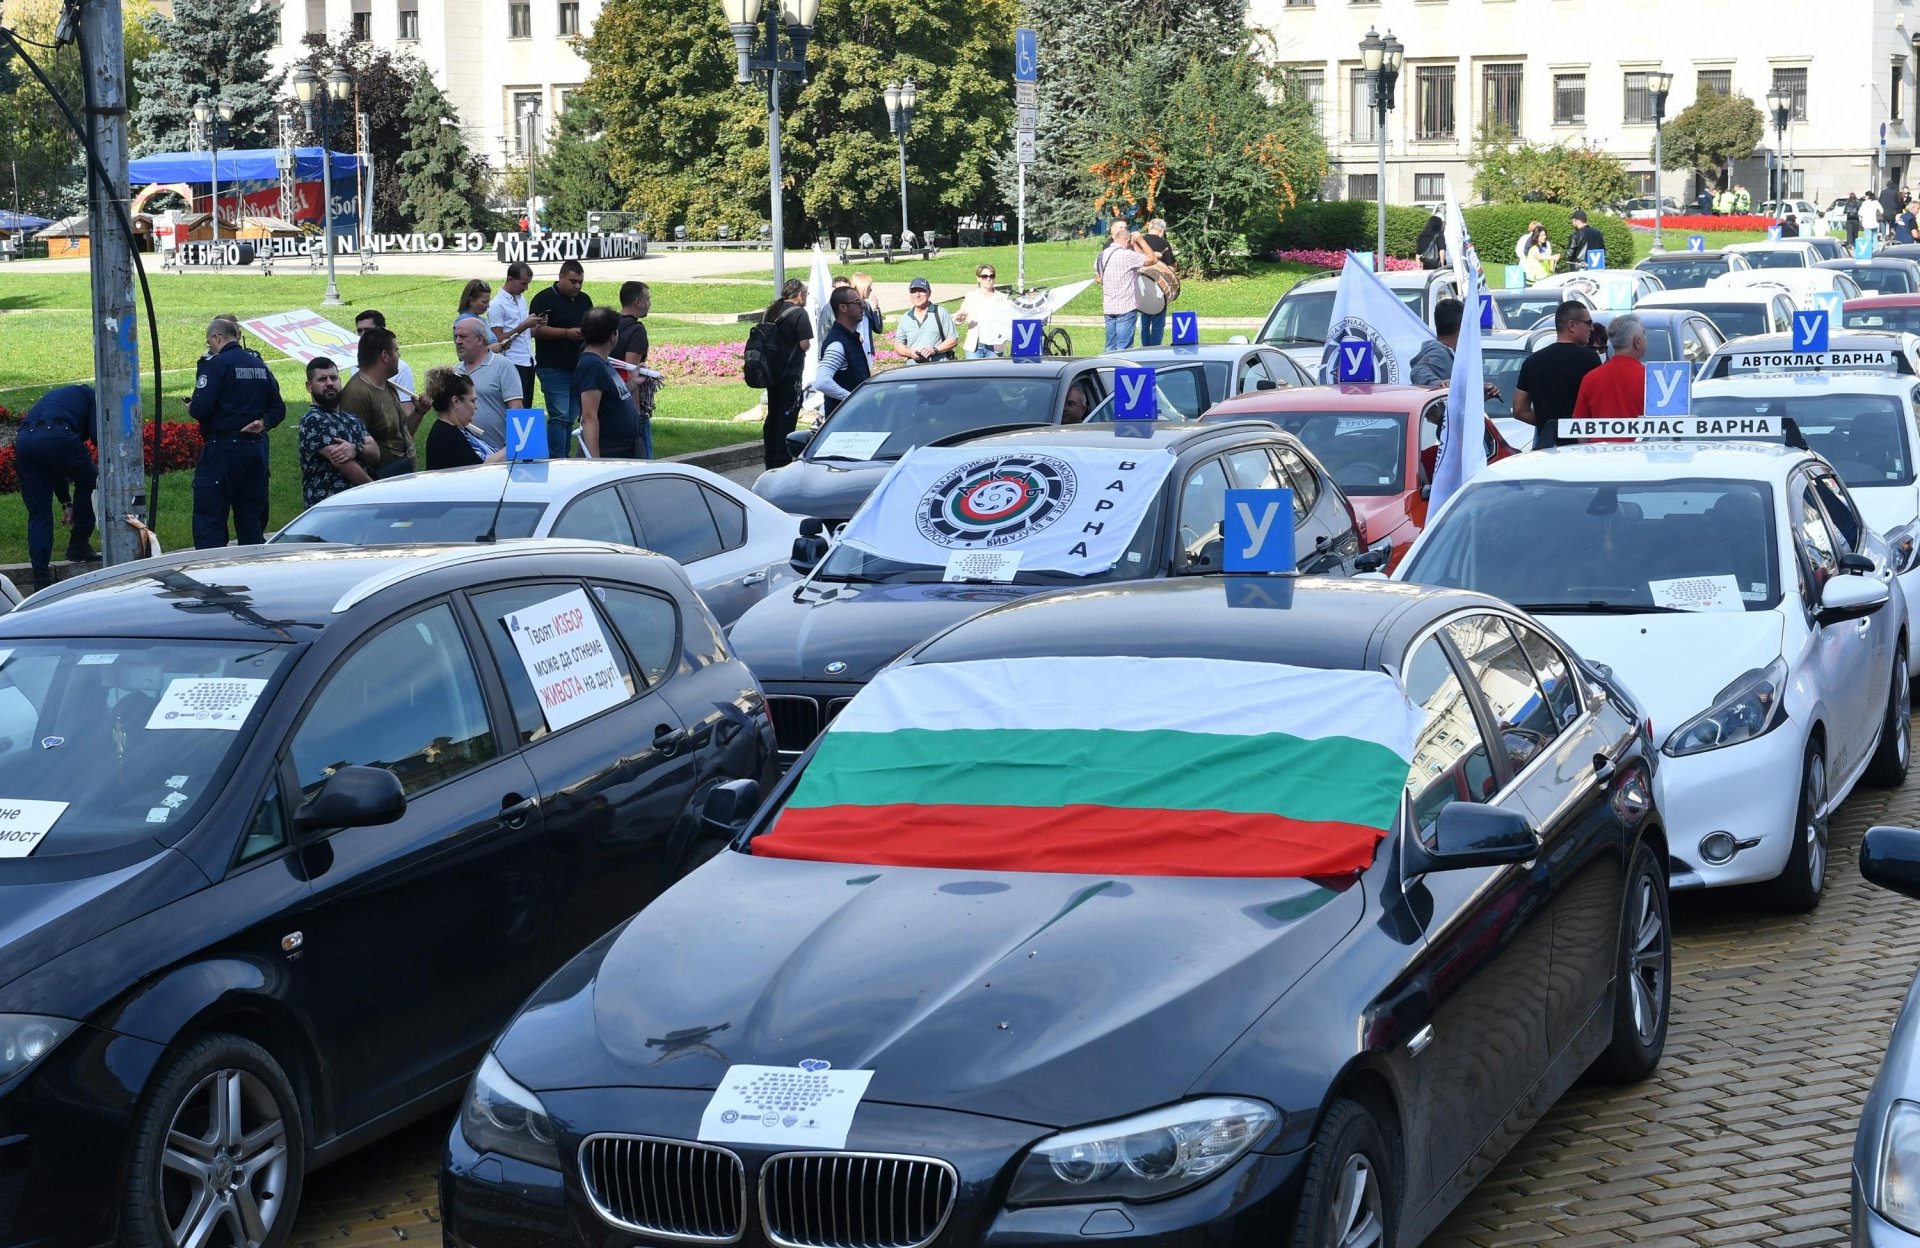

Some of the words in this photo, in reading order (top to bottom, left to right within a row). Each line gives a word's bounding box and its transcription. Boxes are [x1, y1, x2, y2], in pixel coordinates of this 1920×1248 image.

[505, 239, 591, 262] МЕЖДУ
[600, 236, 645, 258] МИНАЛ
[1589, 252, 1601, 267] У
[1858, 240, 1869, 255] У
[1017, 323, 1036, 349] У
[1176, 317, 1192, 338] У
[1801, 315, 1822, 346] У
[1345, 347, 1366, 376] У
[1743, 354, 1825, 367] АВТОКЛАС
[1832, 351, 1885, 365] ВАРНА
[1120, 374, 1147, 411] У
[1653, 369, 1683, 408] У
[512, 416, 536, 452] У
[1569, 419, 1685, 436] АВТОКЛАС
[1696, 418, 1770, 435] ВАРНА
[957, 469, 1045, 498] АКАБ
[930, 454, 1014, 494] КВАЛИФИКАЦИЯ
[986, 523, 1044, 547] БЪЛГАРИЯ
[1068, 461, 1137, 558] ВАРНА
[1235, 502, 1280, 559] У
[524, 624, 555, 646] Твоят
[552, 608, 584, 636] ИЗБОР
[533, 656, 560, 678] може
[559, 652, 573, 671] да
[571, 639, 603, 663] отнеме
[540, 675, 586, 709] ЖИВОТА
[582, 675, 596, 692] на
[595, 660, 619, 691] друг!
[0, 809, 21, 820] не
